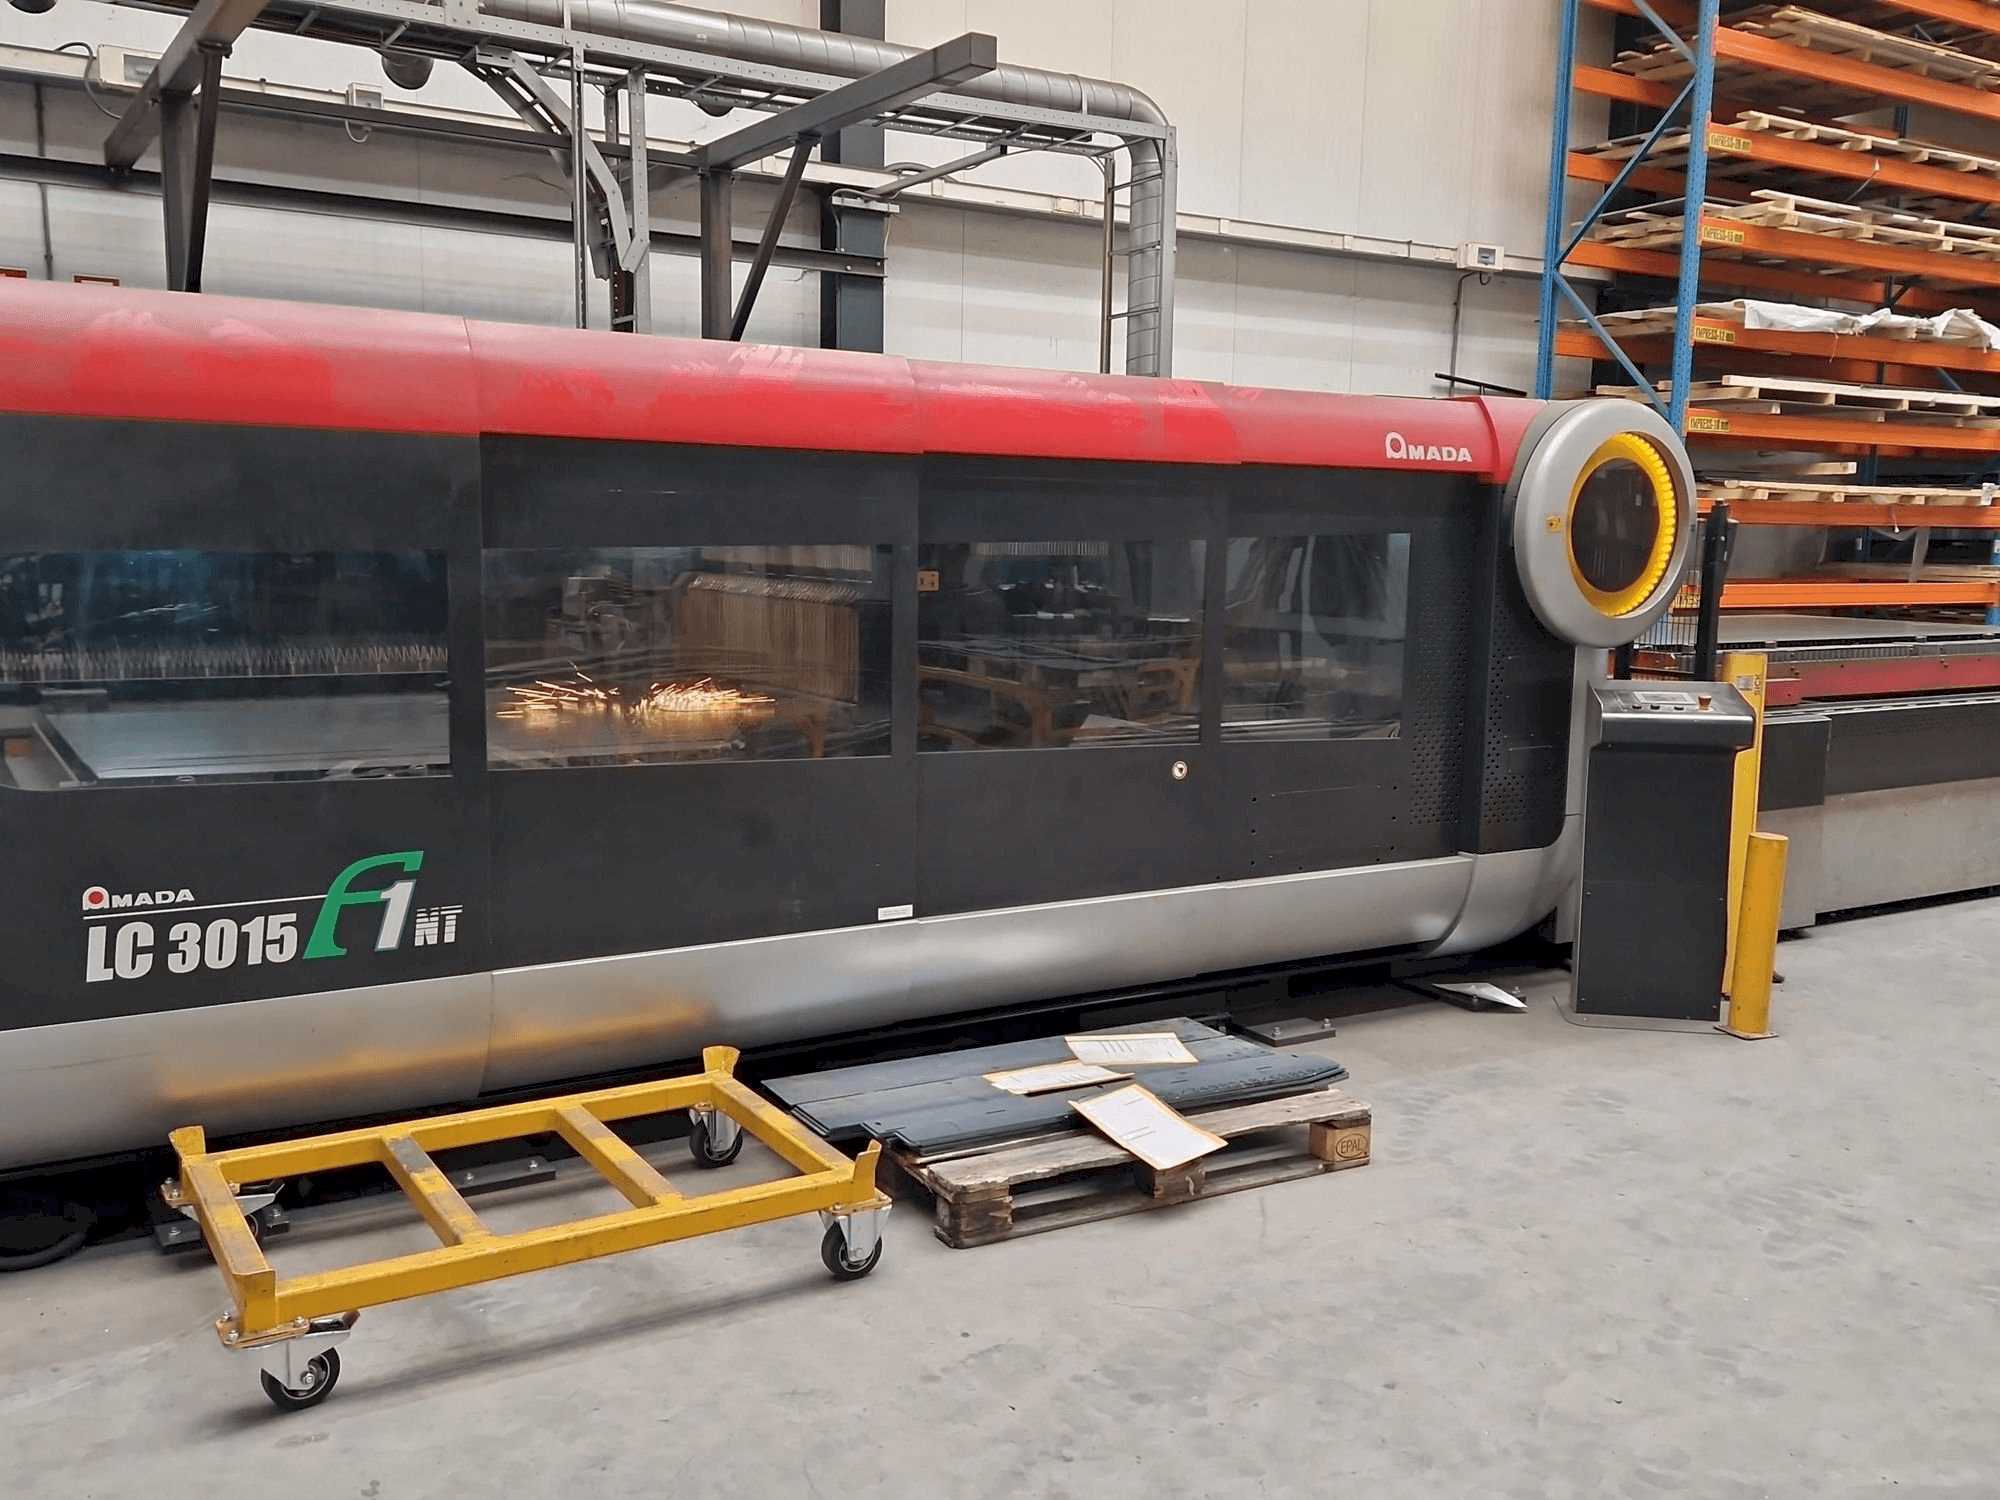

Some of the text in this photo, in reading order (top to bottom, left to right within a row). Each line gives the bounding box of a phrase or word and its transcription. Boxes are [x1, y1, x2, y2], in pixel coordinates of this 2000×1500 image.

[1385, 432, 1473, 462] AMADA
[82, 886, 195, 911] AMADA
[86, 921, 155, 983] LC
[167, 912, 299, 974] 3015
[414, 904, 463, 947] NT
[1340, 1138, 1363, 1154] EPAL
